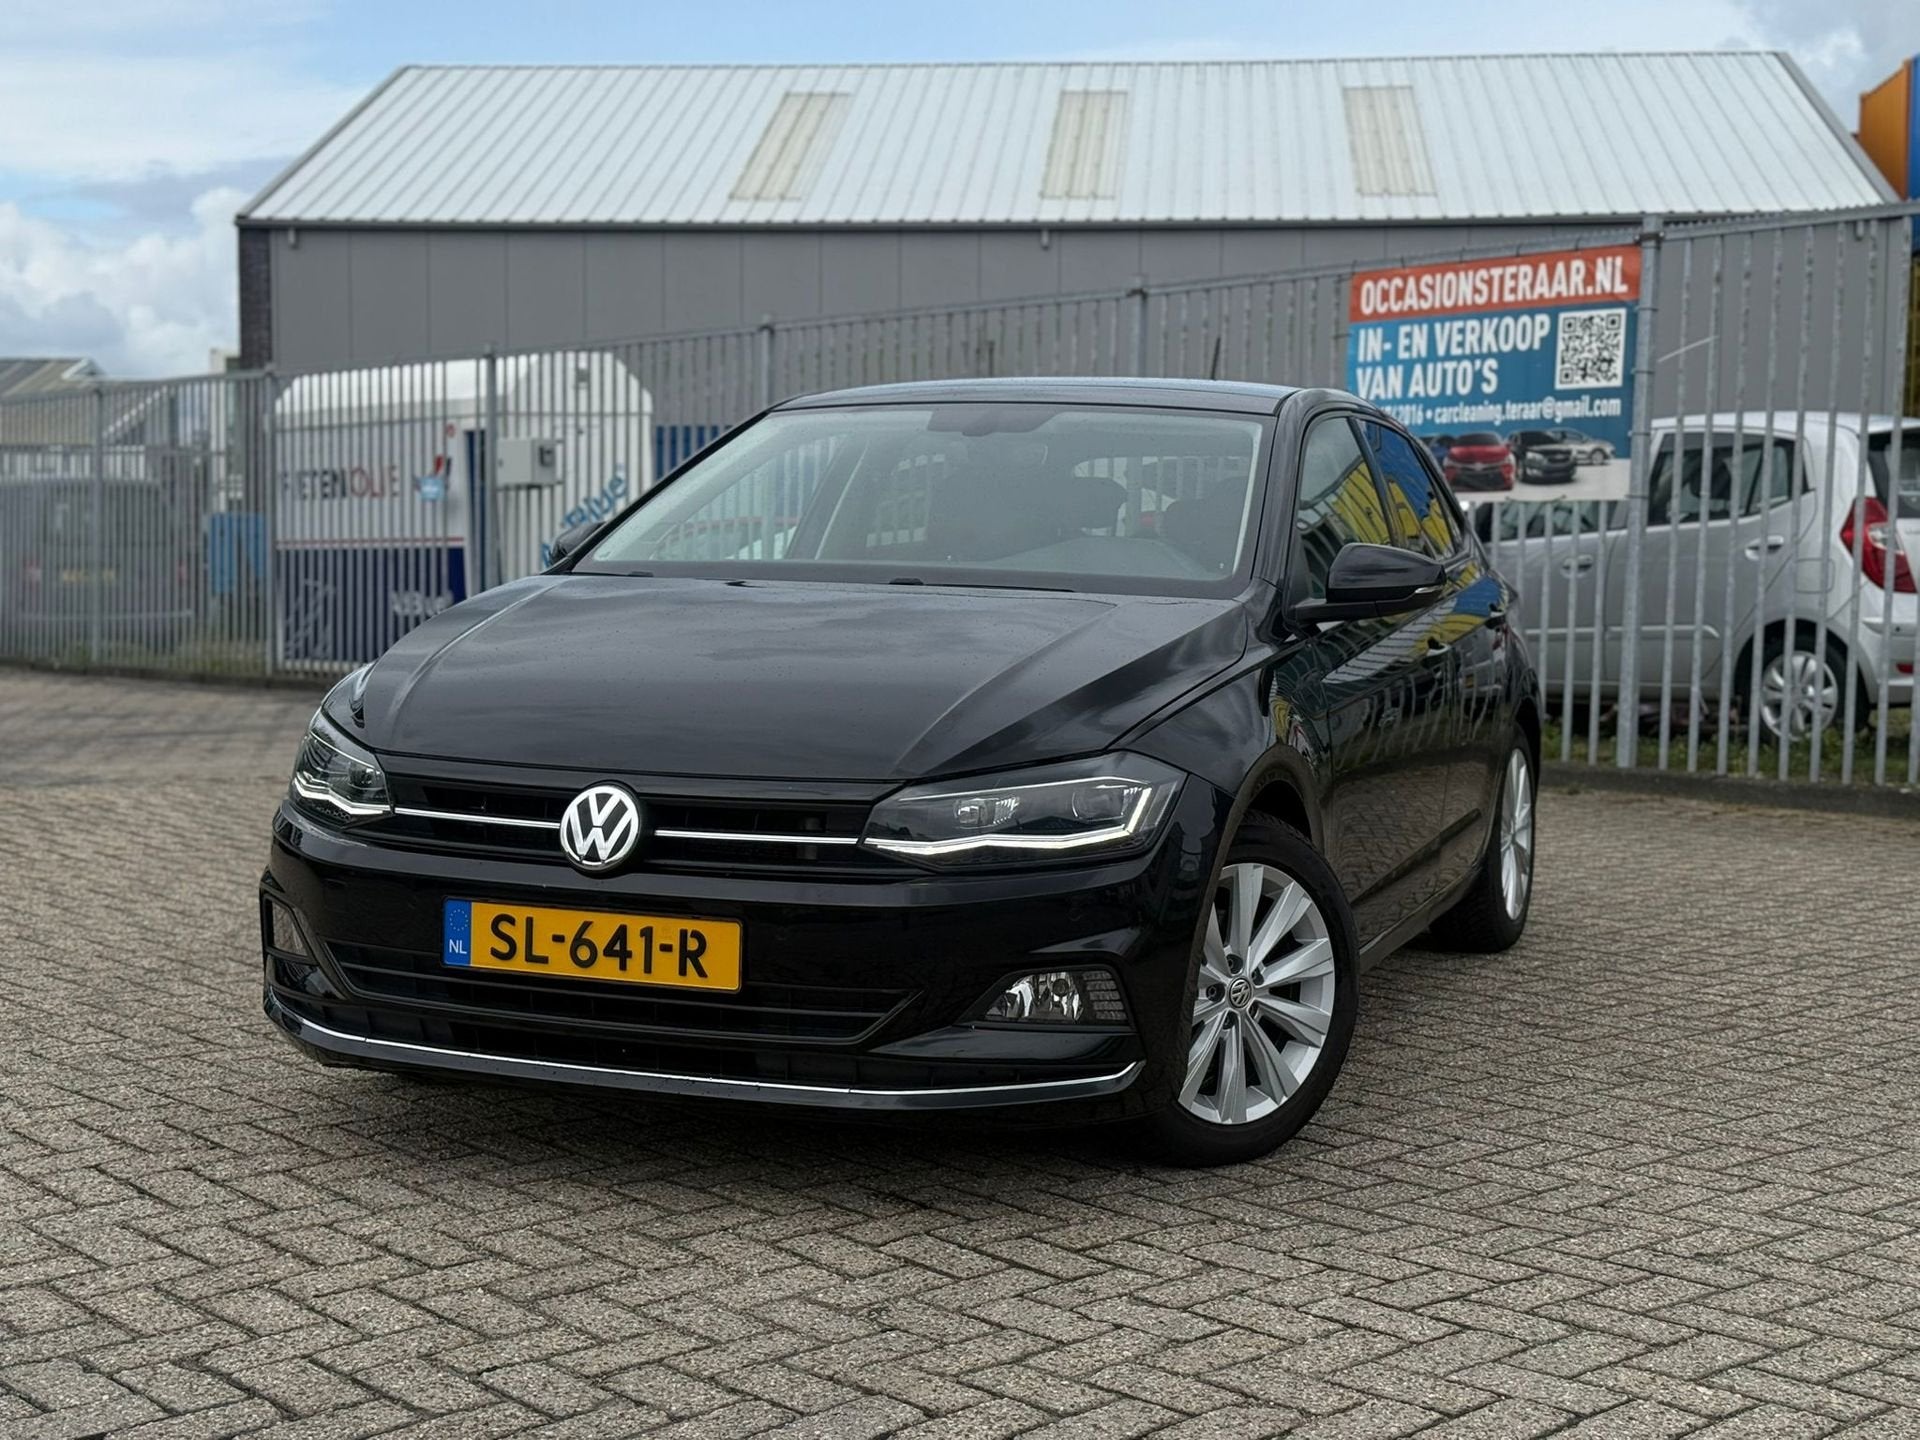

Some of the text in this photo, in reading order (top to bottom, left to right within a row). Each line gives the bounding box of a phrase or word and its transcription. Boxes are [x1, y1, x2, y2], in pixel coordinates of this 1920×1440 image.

[1360, 256, 1628, 314] OCCASIONSTERAAR.NL
[1357, 313, 1551, 363] IN- EN VERKOOP
[1356, 358, 1499, 400] VAN AUTO'S
[1434, 395, 1621, 425] carcleaning.teraar@gmail.com
[448, 913, 709, 979] NL SL-641-R
